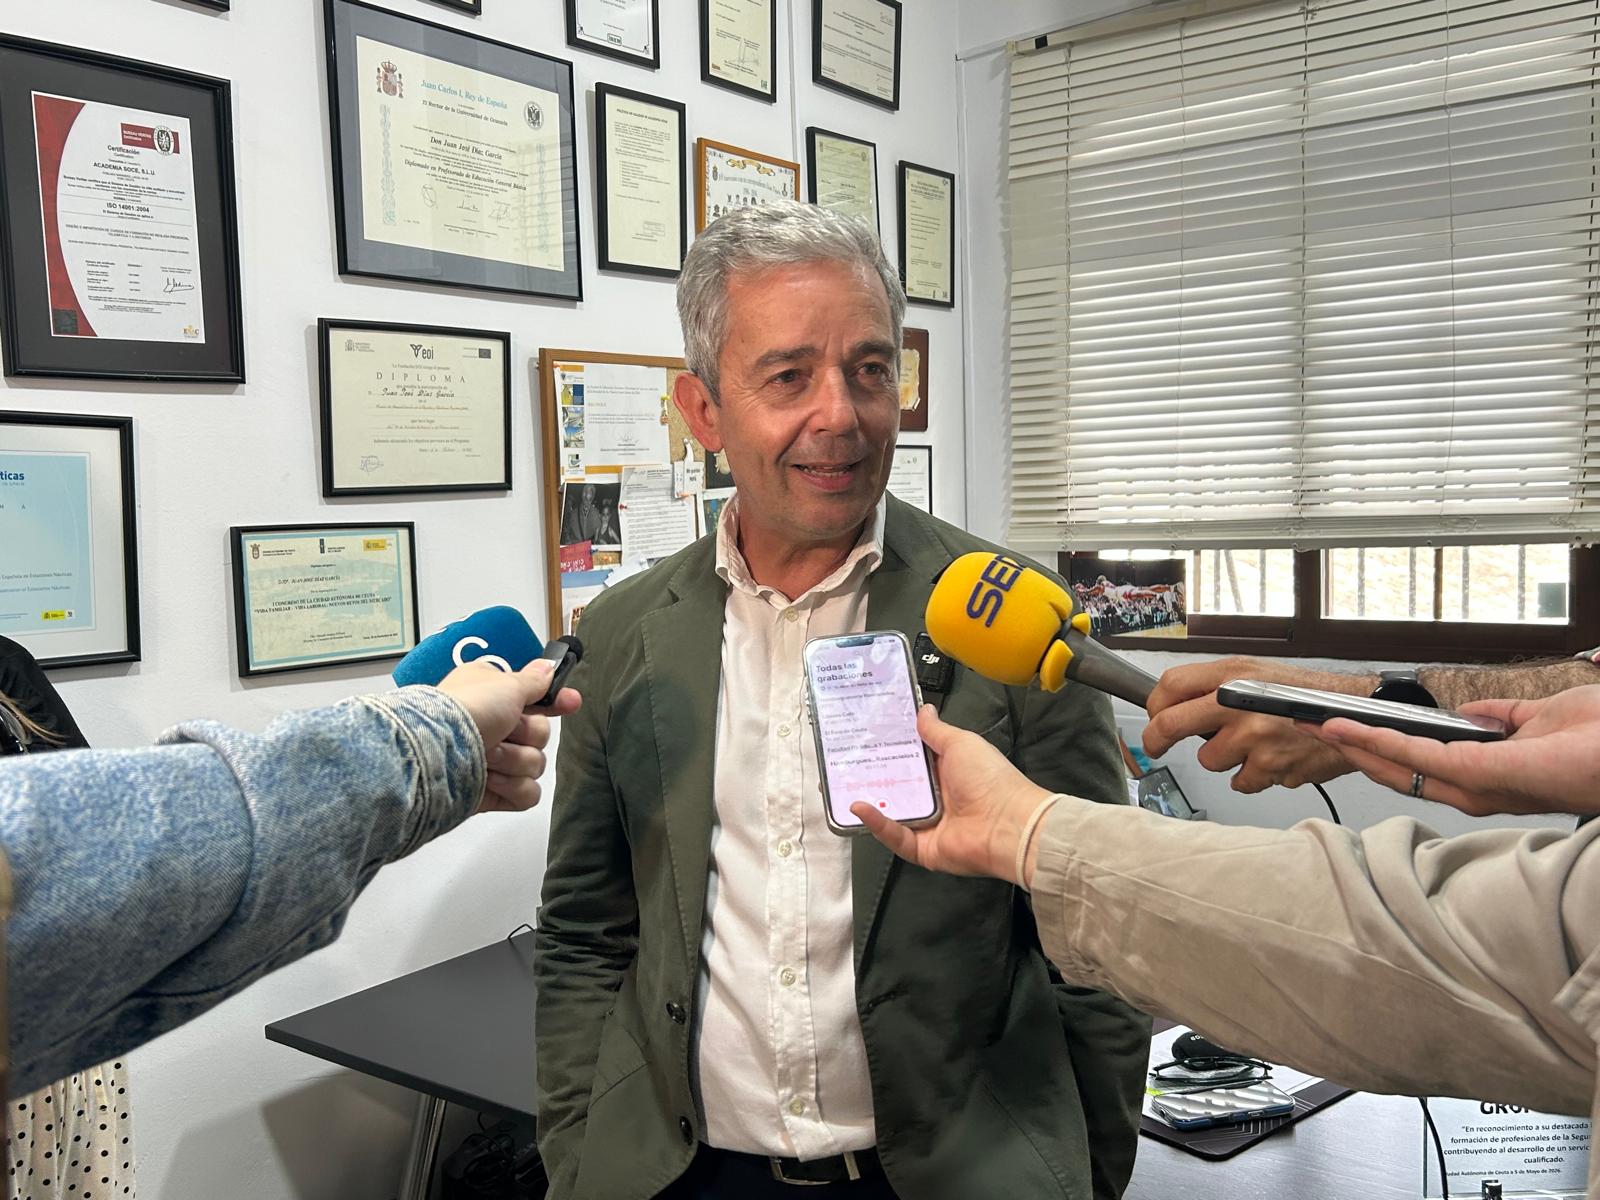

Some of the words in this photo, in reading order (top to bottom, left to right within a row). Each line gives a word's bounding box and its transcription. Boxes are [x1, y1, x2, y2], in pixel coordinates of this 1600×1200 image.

[421, 80, 436, 90] Juan
[438, 84, 457, 95] Carlos
[466, 91, 475, 101] Rey
[487, 97, 507, 109] España
[108, 145, 140, 154] Certificación
[93, 162, 122, 171] ACADEMIA
[119, 204, 149, 212] 14001:2004
[817, 672, 873, 683] grabaciones
[1476, 1124, 1533, 1132] reconocimiento
[1451, 1136, 1488, 1144] formación
[1501, 1134, 1550, 1143] profesionales
[1444, 1147, 1497, 1155] contribuyendo
[1507, 1145, 1544, 1153] desarrollo
